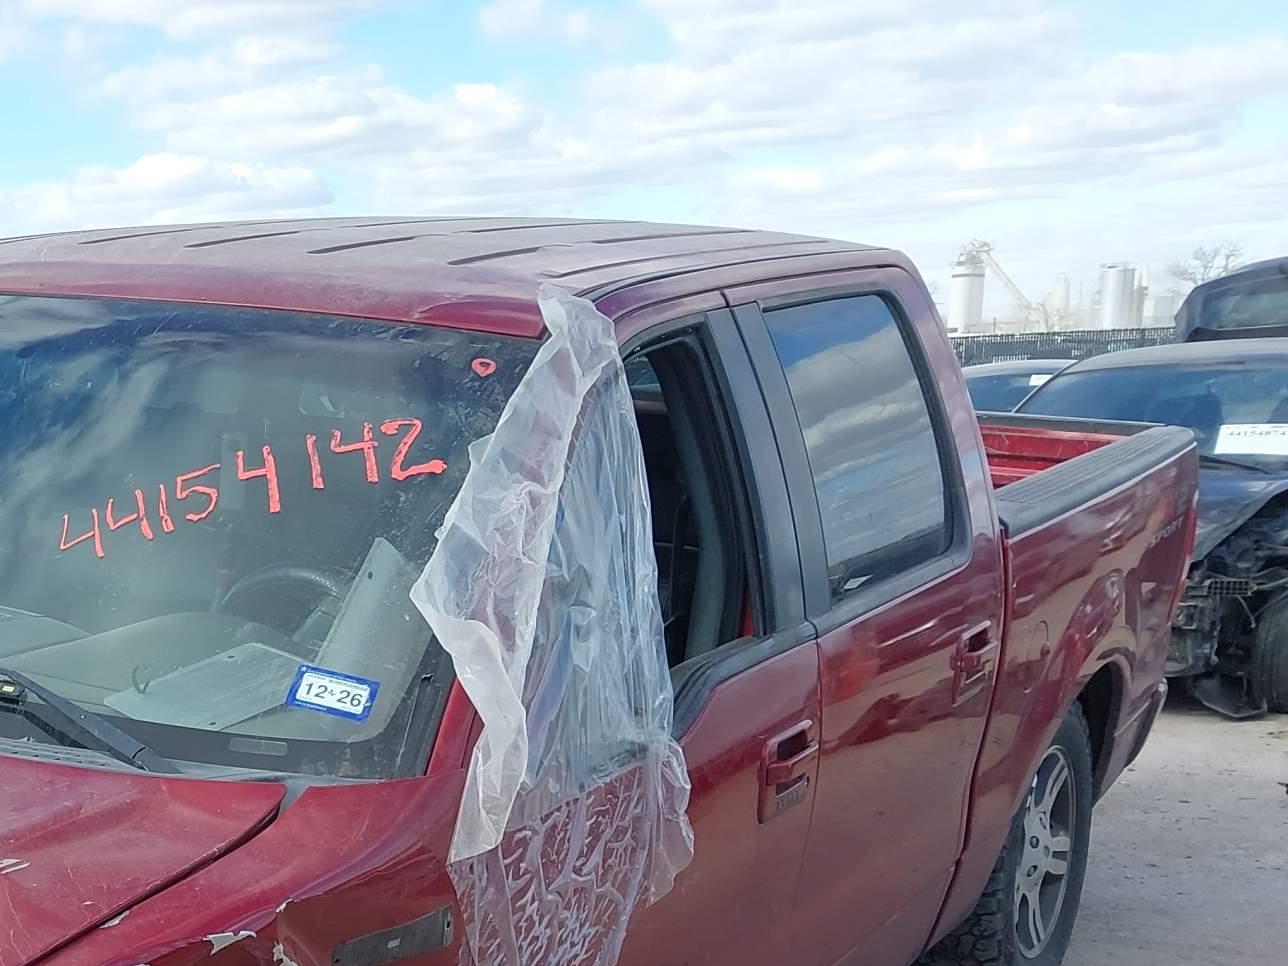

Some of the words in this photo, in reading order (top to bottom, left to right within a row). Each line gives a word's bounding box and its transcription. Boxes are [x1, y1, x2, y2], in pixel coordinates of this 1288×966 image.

[58, 416, 448, 559] 44154142
[305, 682, 329, 700] 12
[336, 689, 364, 708] 26
